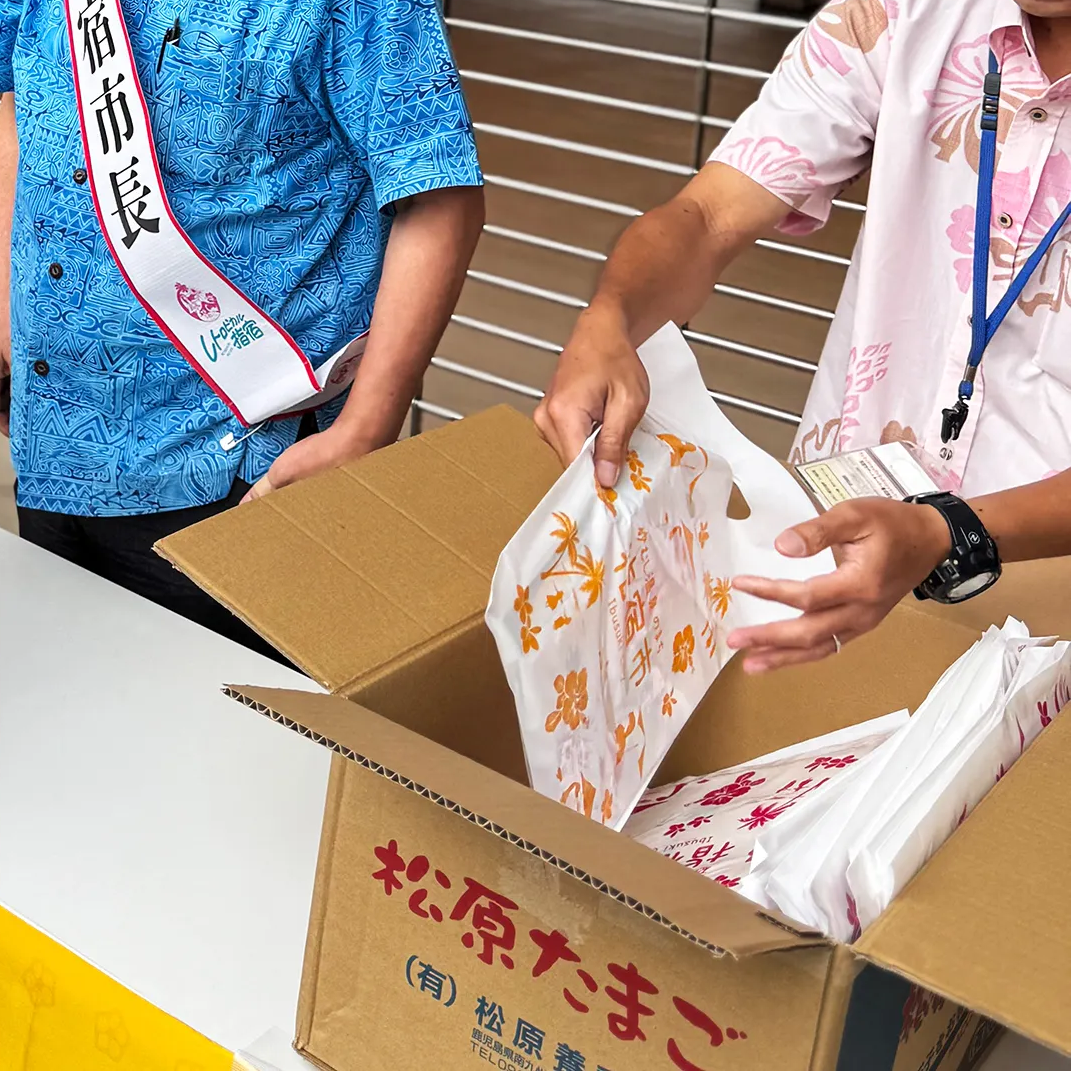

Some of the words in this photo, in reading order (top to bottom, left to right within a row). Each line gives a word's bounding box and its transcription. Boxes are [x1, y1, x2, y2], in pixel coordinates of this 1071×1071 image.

[371, 839, 748, 1071] 松原たまご
[474, 995, 617, 1071] 松原養
